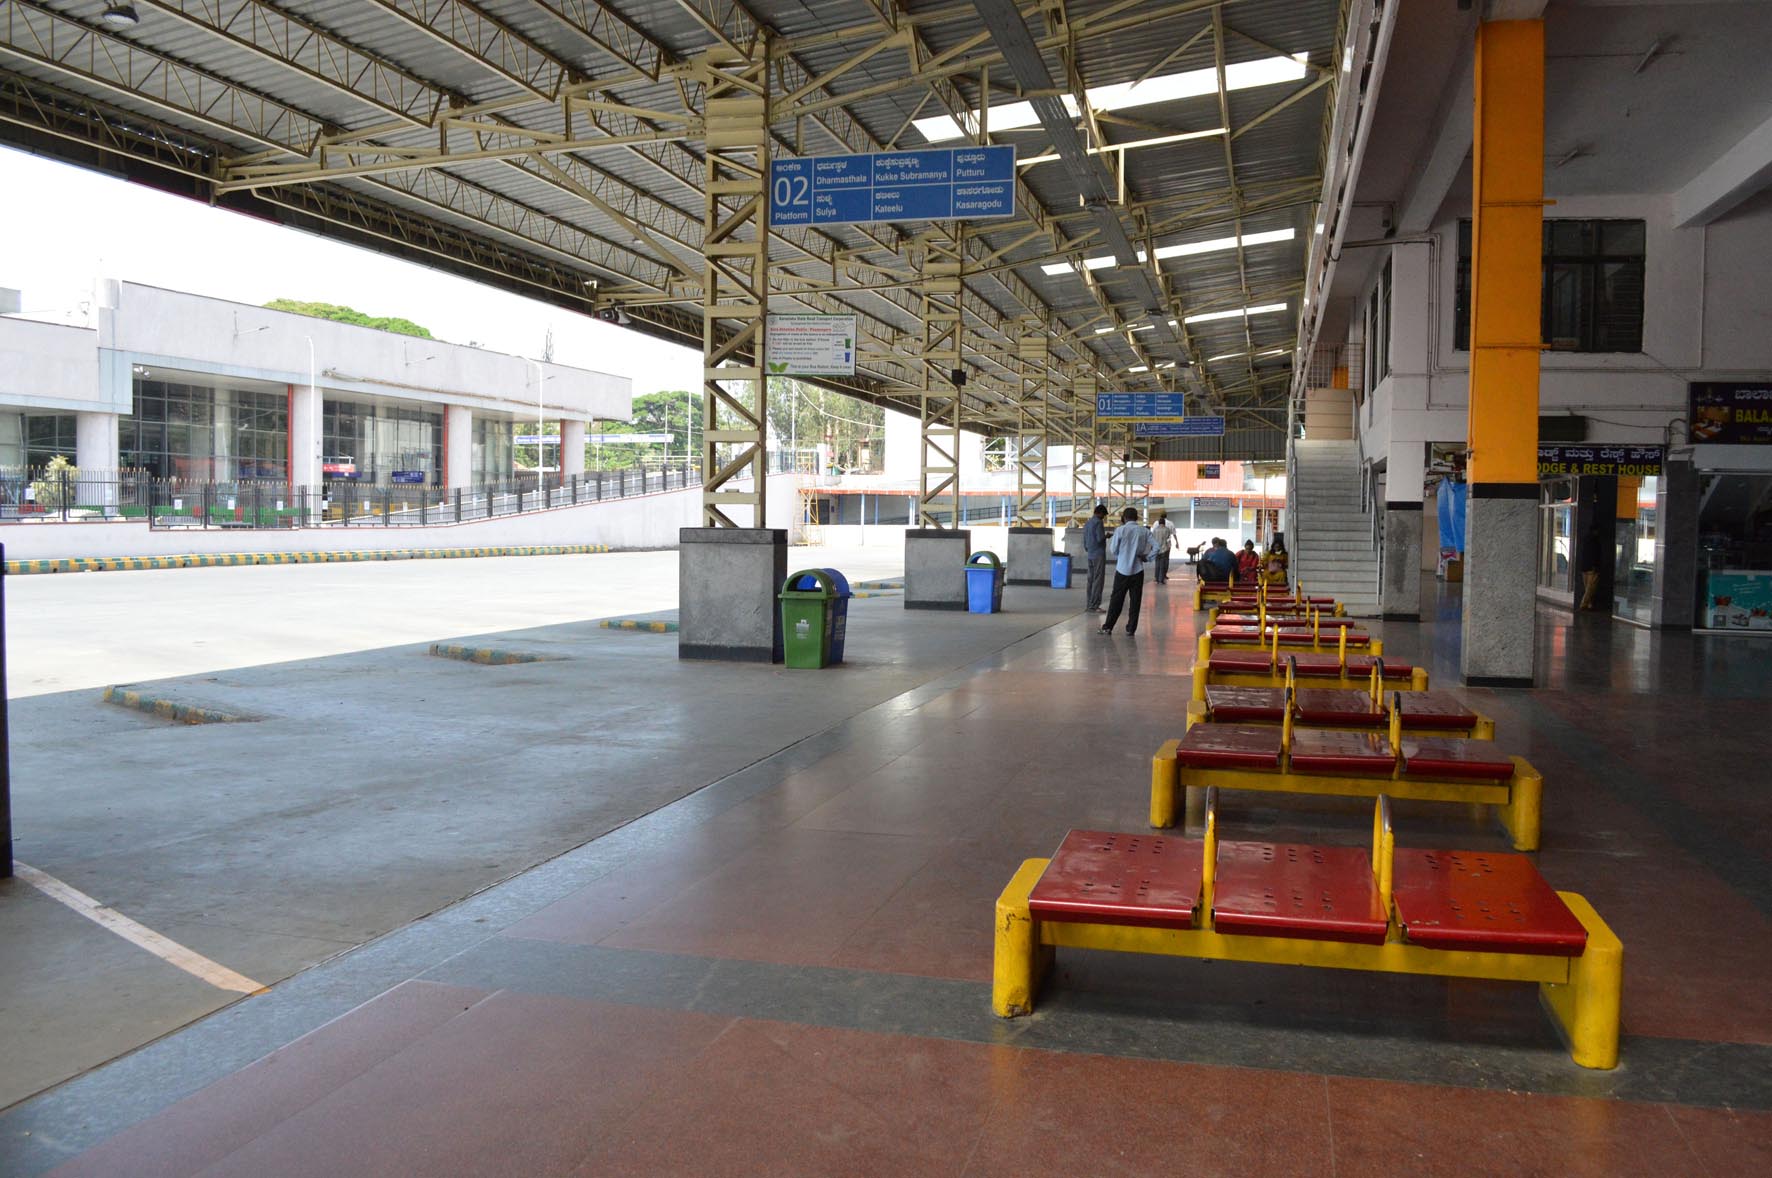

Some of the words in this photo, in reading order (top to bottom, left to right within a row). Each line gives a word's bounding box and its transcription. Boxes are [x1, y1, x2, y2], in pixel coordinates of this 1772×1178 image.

[875, 173, 899, 182] Kukke
[900, 170, 947, 180] Subramanya
[956, 168, 985, 177] Putturu
[816, 174, 867, 185] Dharmasthala
[774, 176, 809, 207] 02
[875, 203, 903, 213] Kateelu
[956, 199, 1003, 210] Kasaragodu
[775, 211, 808, 221] Platform
[1098, 398, 1112, 410] 01
[1565, 448, 1594, 462] ಮತ್ತು
[1570, 463, 1579, 474] &
[1583, 463, 1615, 475] REST
[1618, 464, 1661, 475] HOUSE
